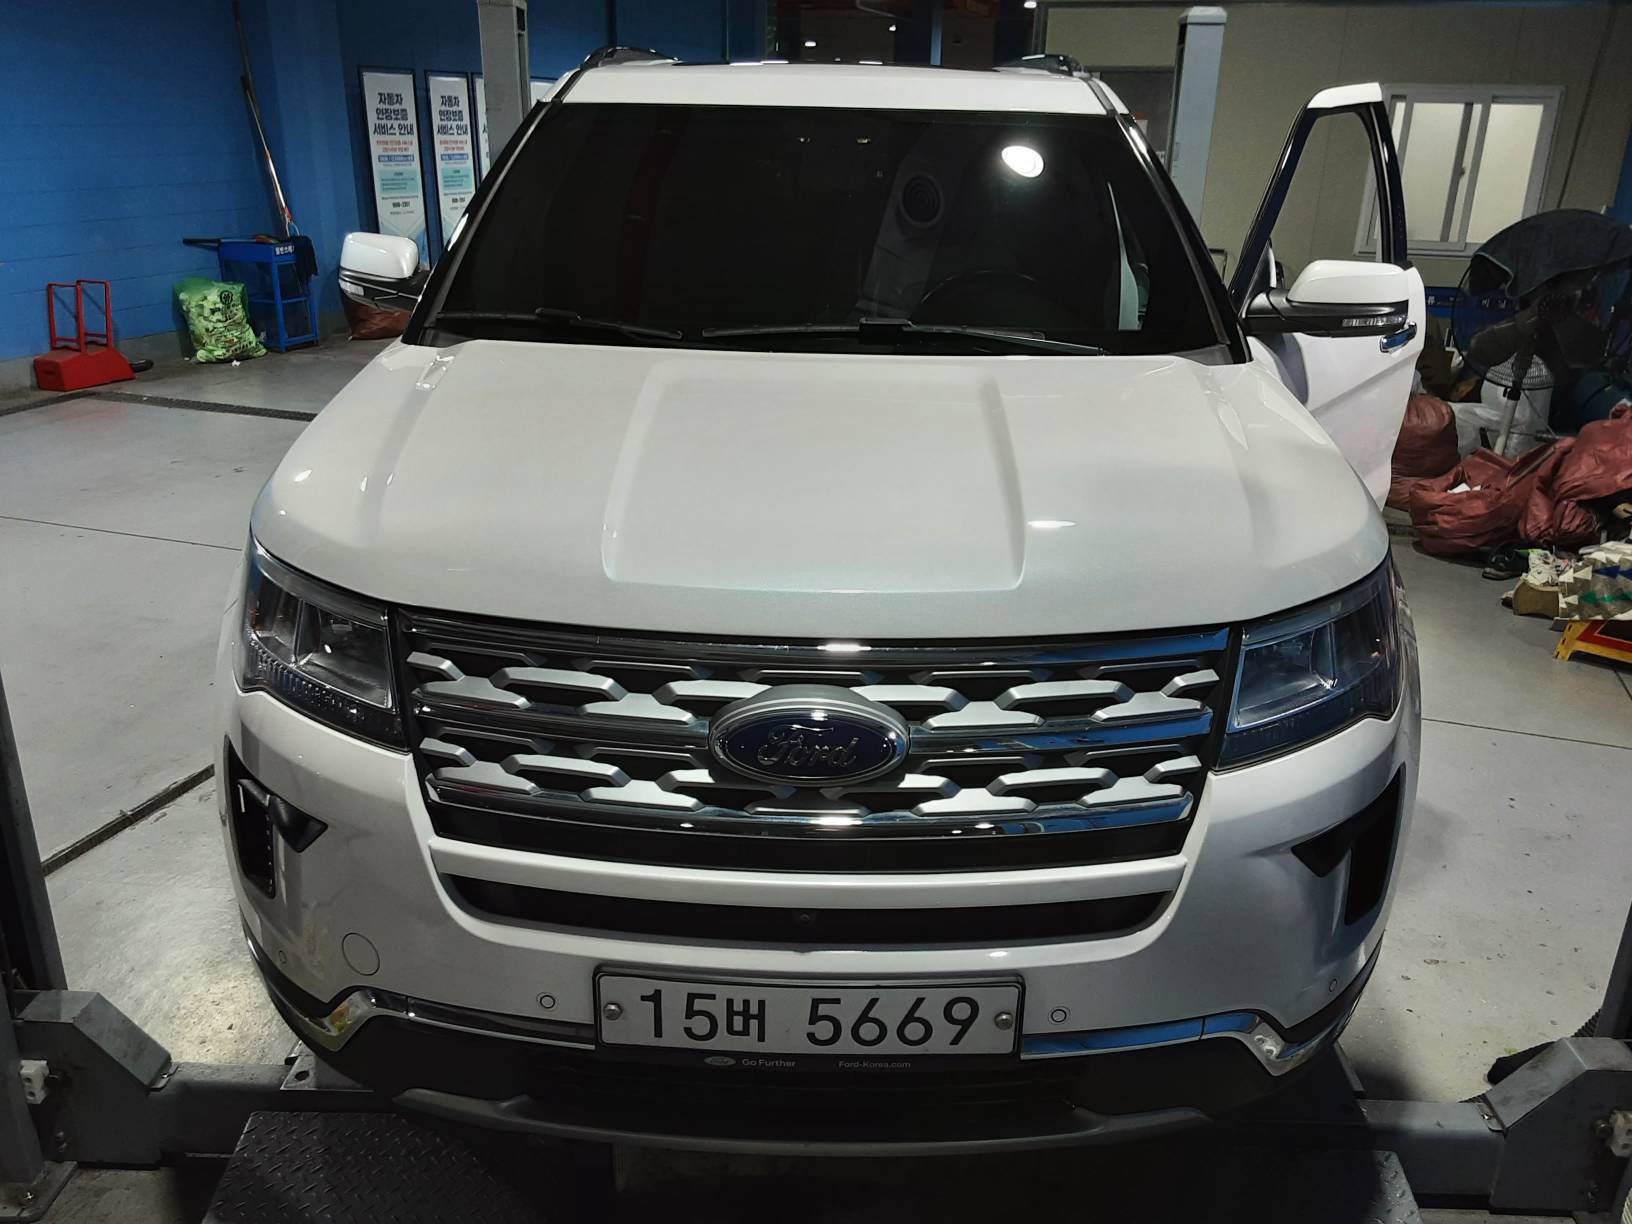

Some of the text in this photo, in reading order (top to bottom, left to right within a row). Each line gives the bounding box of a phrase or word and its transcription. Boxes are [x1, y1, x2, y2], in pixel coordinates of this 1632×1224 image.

[378, 92, 403, 105] 자동차
[440, 95, 460, 108] 자동차
[376, 107, 408, 121] 연장보증
[373, 123, 414, 135] 서비스 안내
[437, 123, 468, 135] 서비스 안내
[758, 723, 859, 767] Ford
[640, 988, 980, 1046] 15버 5669
[742, 1058, 757, 1066] Go
[758, 1058, 797, 1067] Further
[838, 1060, 911, 1069] Ford-Korea.com
